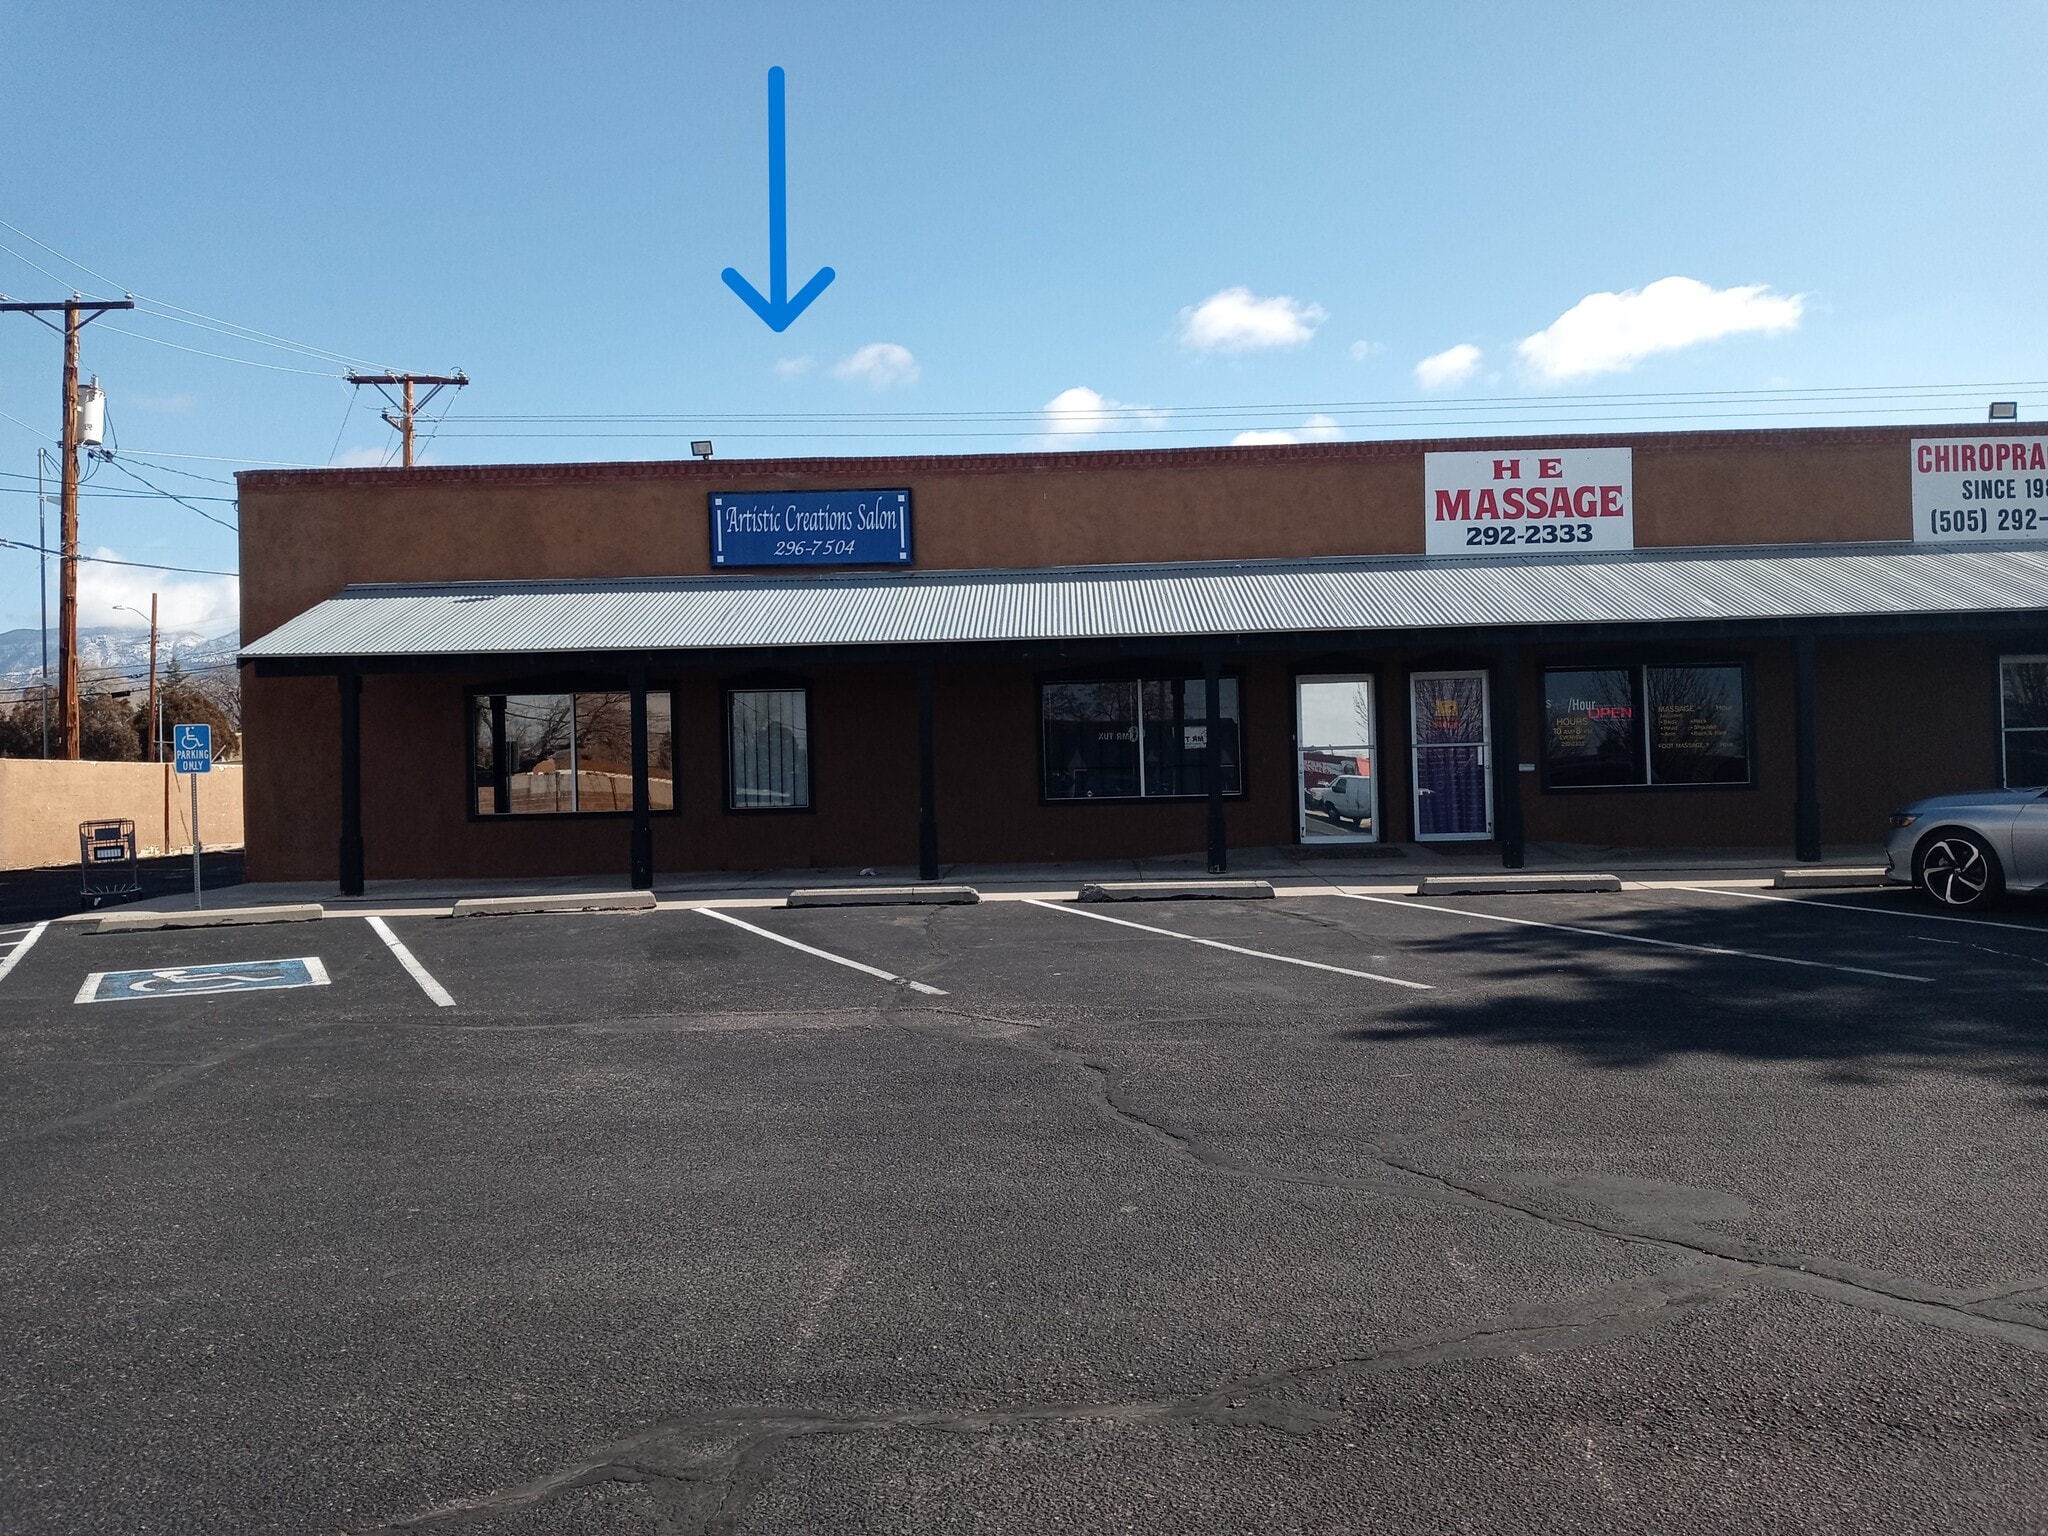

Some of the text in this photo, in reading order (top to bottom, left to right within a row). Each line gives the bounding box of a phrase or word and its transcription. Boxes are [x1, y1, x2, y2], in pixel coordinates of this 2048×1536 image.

[1917, 442, 2048, 474] CHIROPRA
[1492, 458, 1563, 480] H E
[1961, 479, 2018, 500] SINCE
[1434, 485, 1624, 522] MASSAGE
[725, 496, 898, 533] Artistic Creations Salon
[1930, 507, 2048, 535] (505) 292-
[1465, 523, 1593, 546] 292-2333
[773, 539, 856, 557] 296-7504
[1556, 717, 1589, 726] HOURS
[1587, 706, 1633, 720] OPEN
[176, 749, 209, 760] PARKING
[182, 760, 204, 771] ONLY
